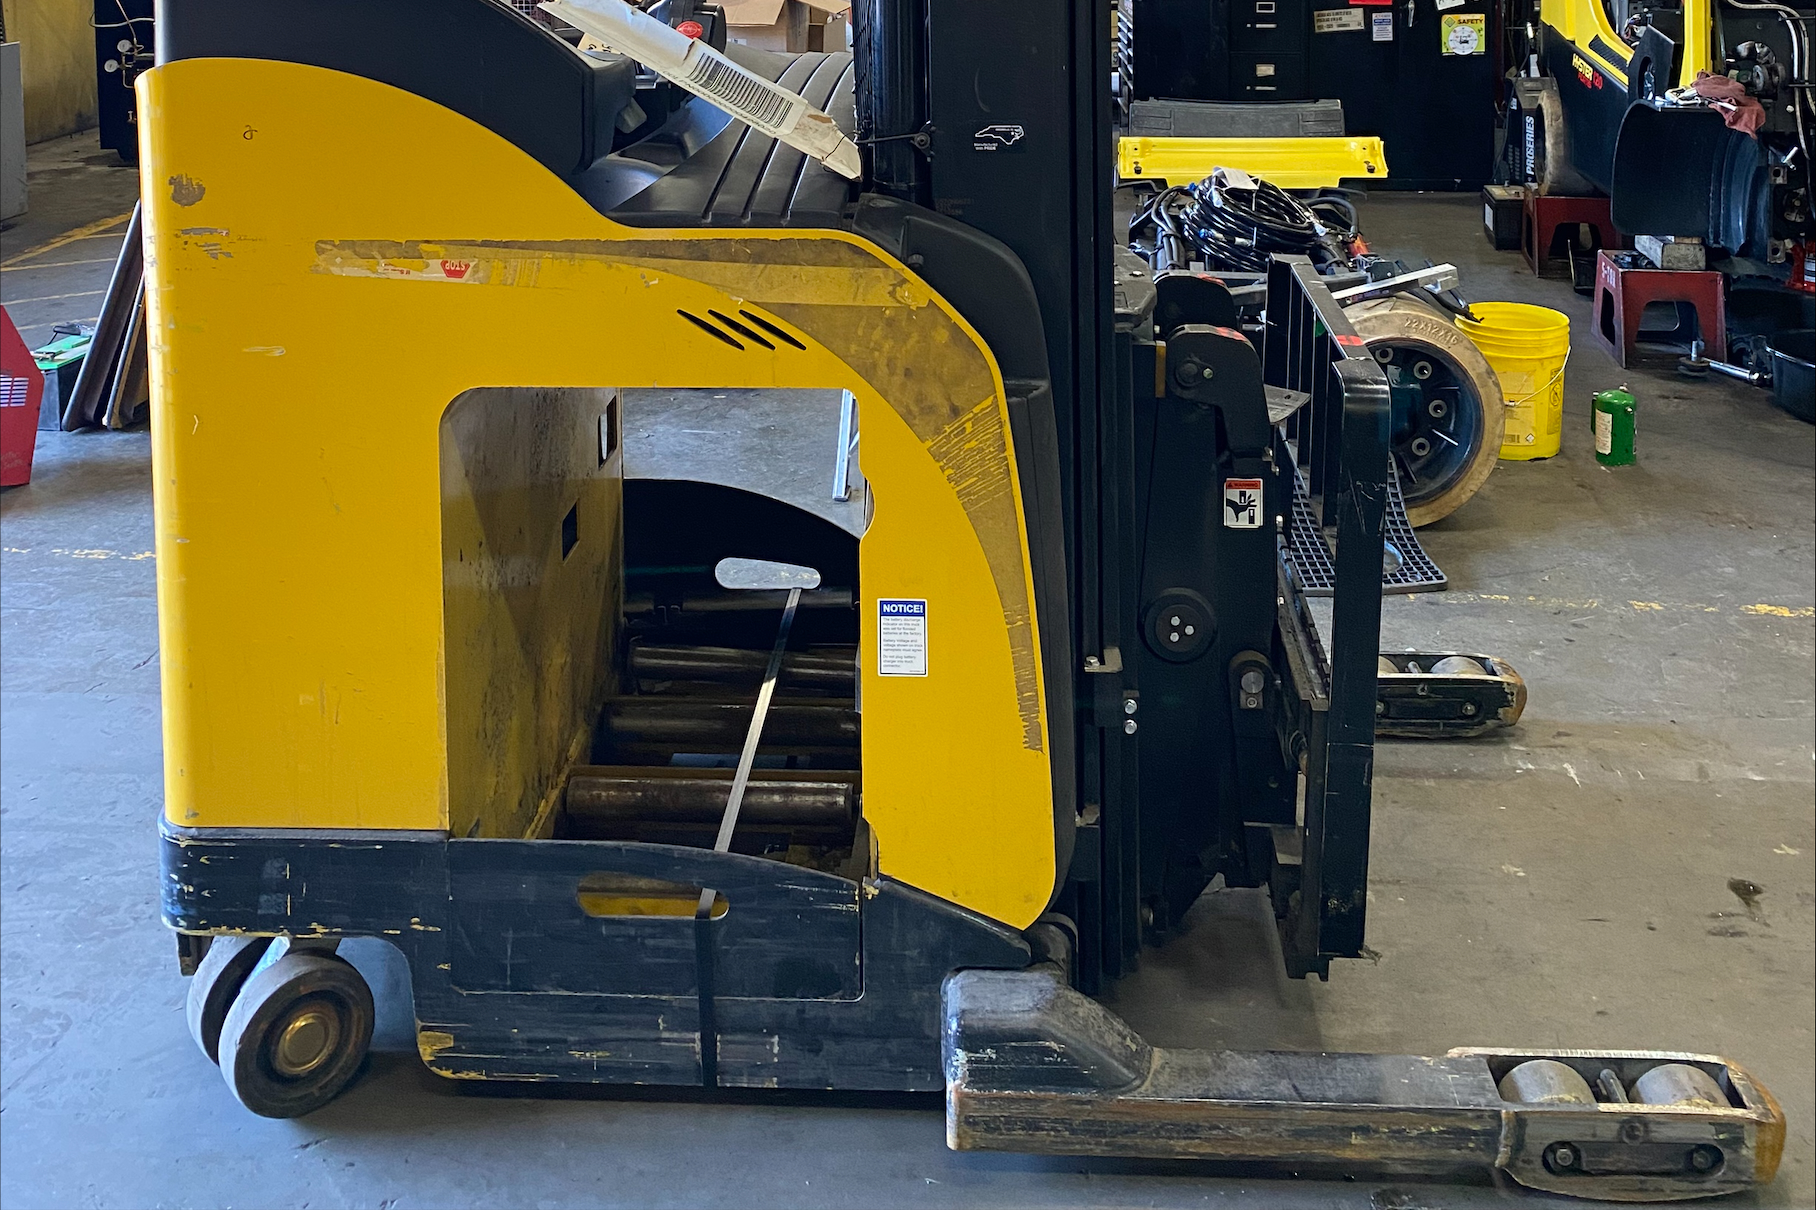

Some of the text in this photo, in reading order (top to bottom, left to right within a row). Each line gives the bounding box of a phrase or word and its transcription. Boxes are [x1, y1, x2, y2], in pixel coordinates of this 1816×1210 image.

[1525, 115, 1535, 175] PROSERIES
[445, 260, 466, 271] STOP
[1404, 316, 1459, 345] 22X12X16
[882, 603, 924, 613] NOTICE!
